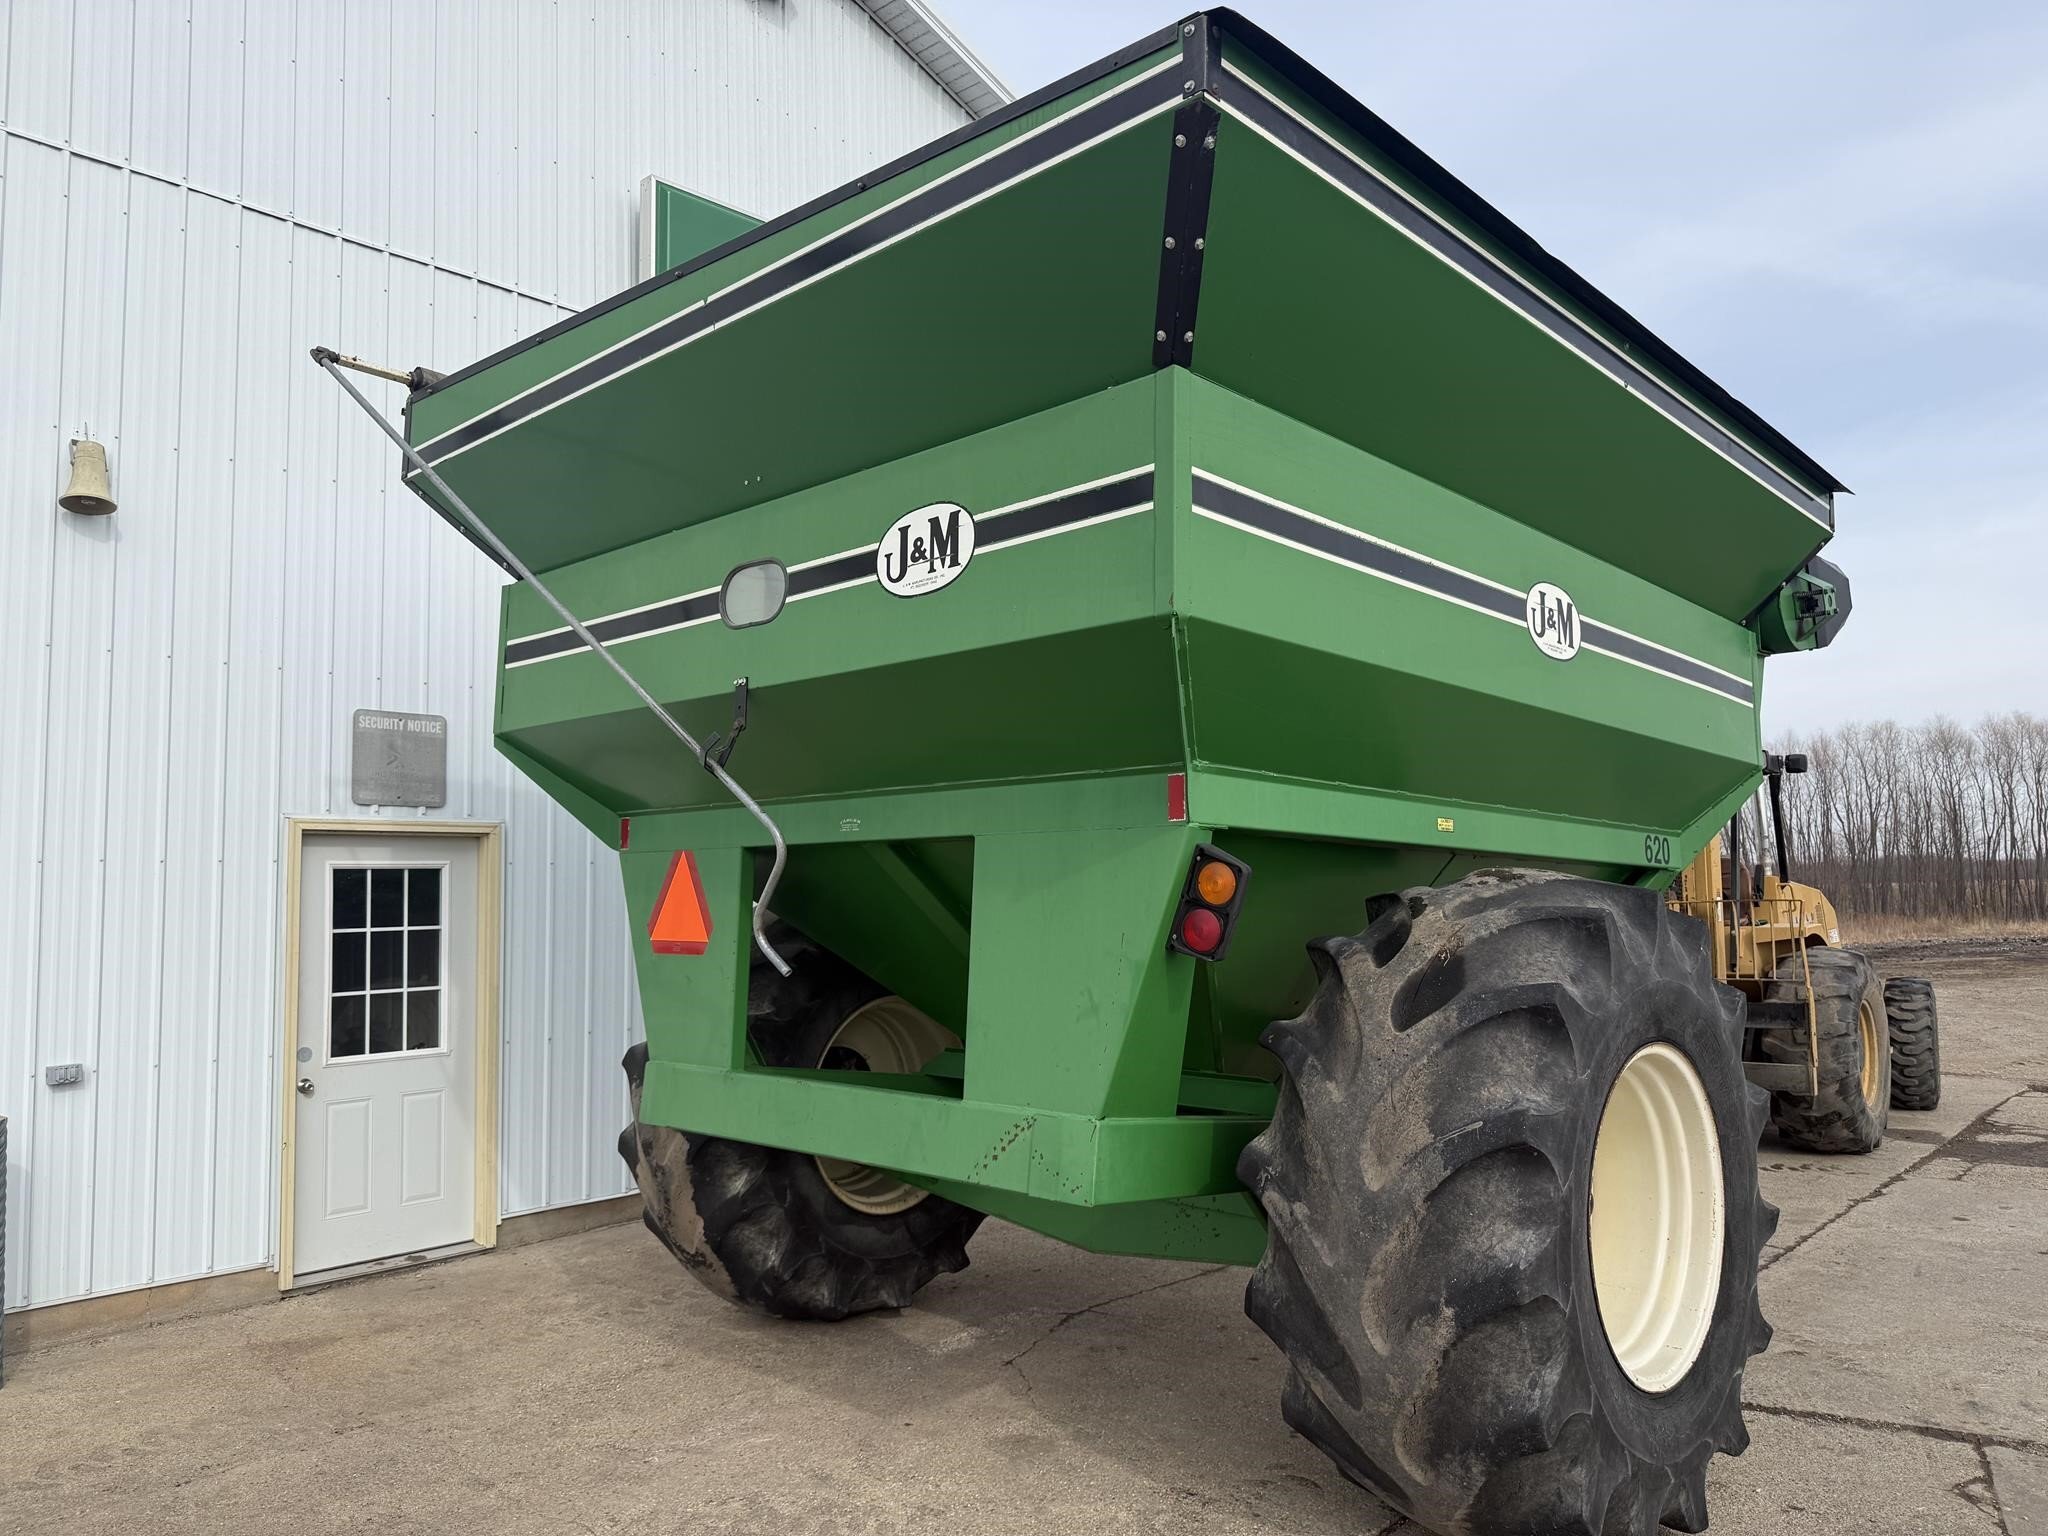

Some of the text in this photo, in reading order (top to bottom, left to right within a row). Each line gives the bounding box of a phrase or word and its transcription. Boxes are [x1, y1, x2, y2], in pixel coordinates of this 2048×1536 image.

[884, 509, 961, 584] J&M
[1531, 590, 1575, 649] J&M
[359, 715, 442, 733] SECURITY NOTICE
[1645, 834, 1670, 865] 620
